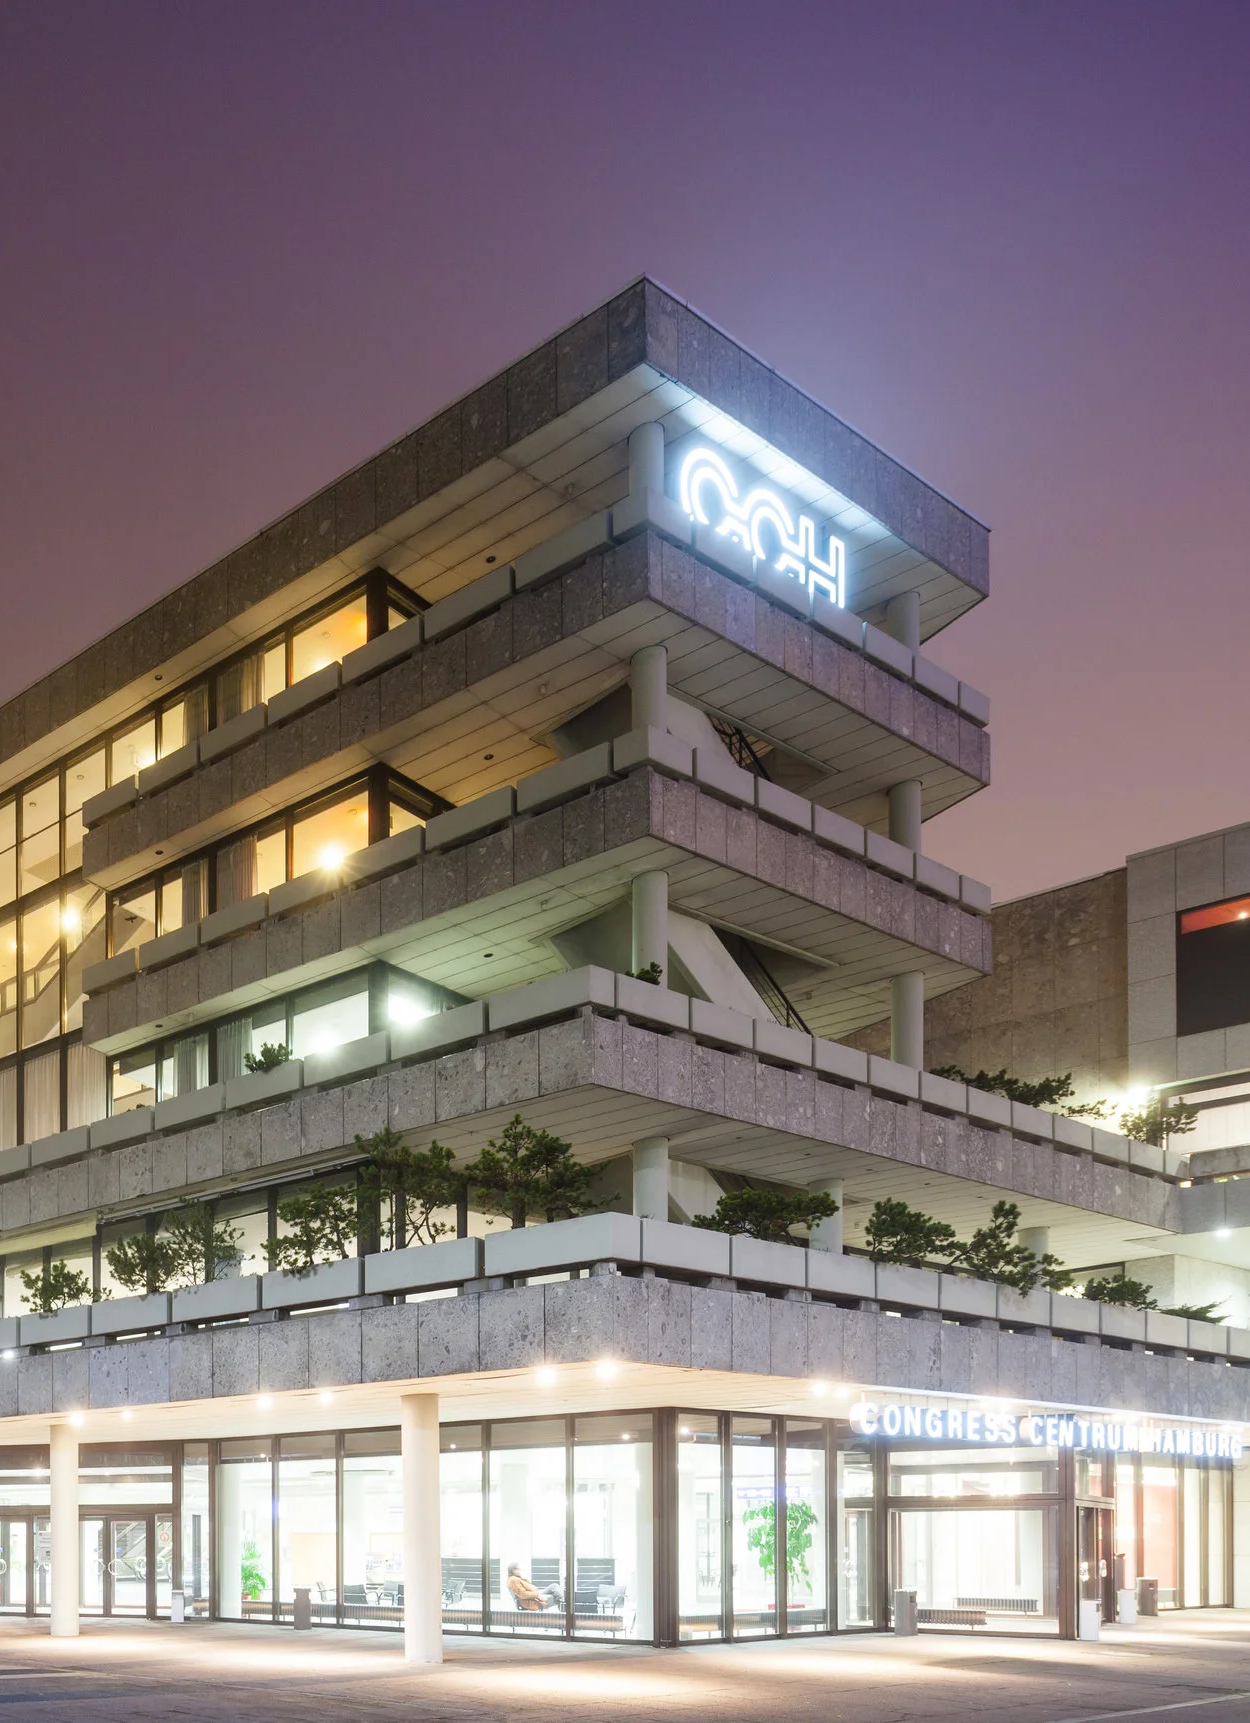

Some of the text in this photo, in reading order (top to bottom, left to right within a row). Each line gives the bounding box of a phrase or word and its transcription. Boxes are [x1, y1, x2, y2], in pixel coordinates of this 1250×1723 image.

[680, 447, 845, 609] CCH
[860, 1402, 1242, 1459] CONGRESS CENTRUM HAMBURG
